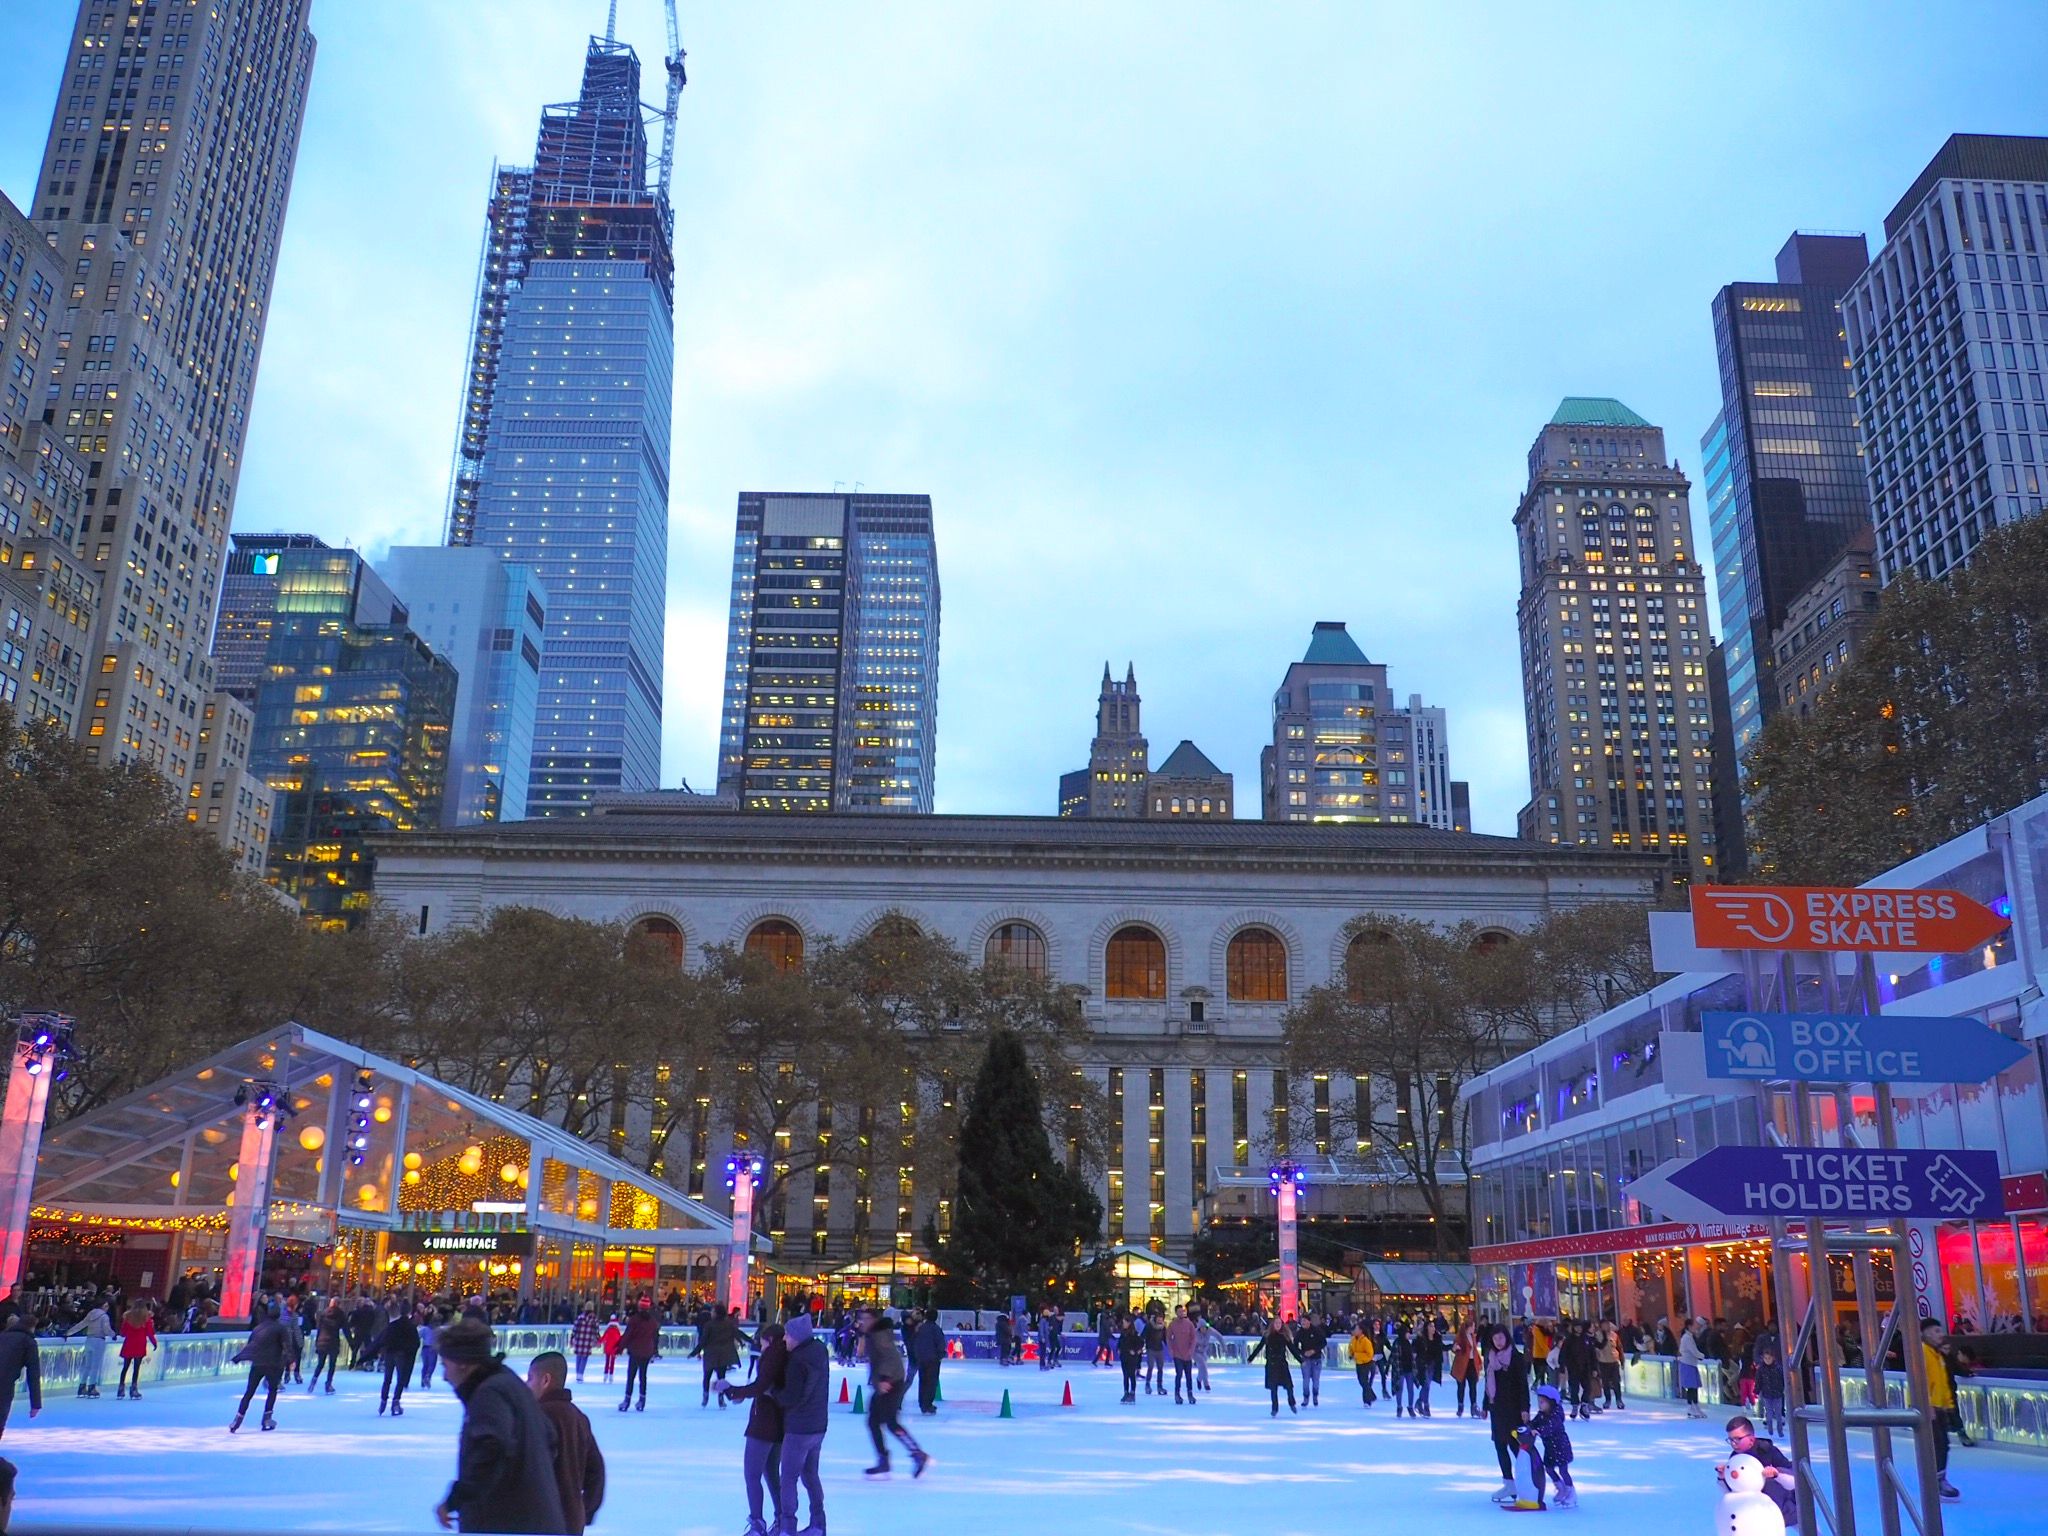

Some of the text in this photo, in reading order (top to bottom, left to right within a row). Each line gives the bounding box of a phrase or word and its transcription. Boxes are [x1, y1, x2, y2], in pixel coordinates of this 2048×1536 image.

[1806, 893, 1957, 920] EXPRESS
[1809, 920, 1918, 946] SKATE
[1791, 1021, 1863, 1047] BOX
[1793, 1049, 1921, 1076] OFFICE
[1782, 1153, 1908, 1182] TICKET
[1744, 1183, 1912, 1211] HOLDERS
[401, 1211, 528, 1233] THE LODGE
[1698, 1223, 1723, 1238] Winter
[1724, 1223, 1751, 1238] Village
[432, 1238, 497, 1250] URBANSPACE
[1645, 1230, 1686, 1243] BANK OF AMERICA
[1064, 1345, 1081, 1354] hour
